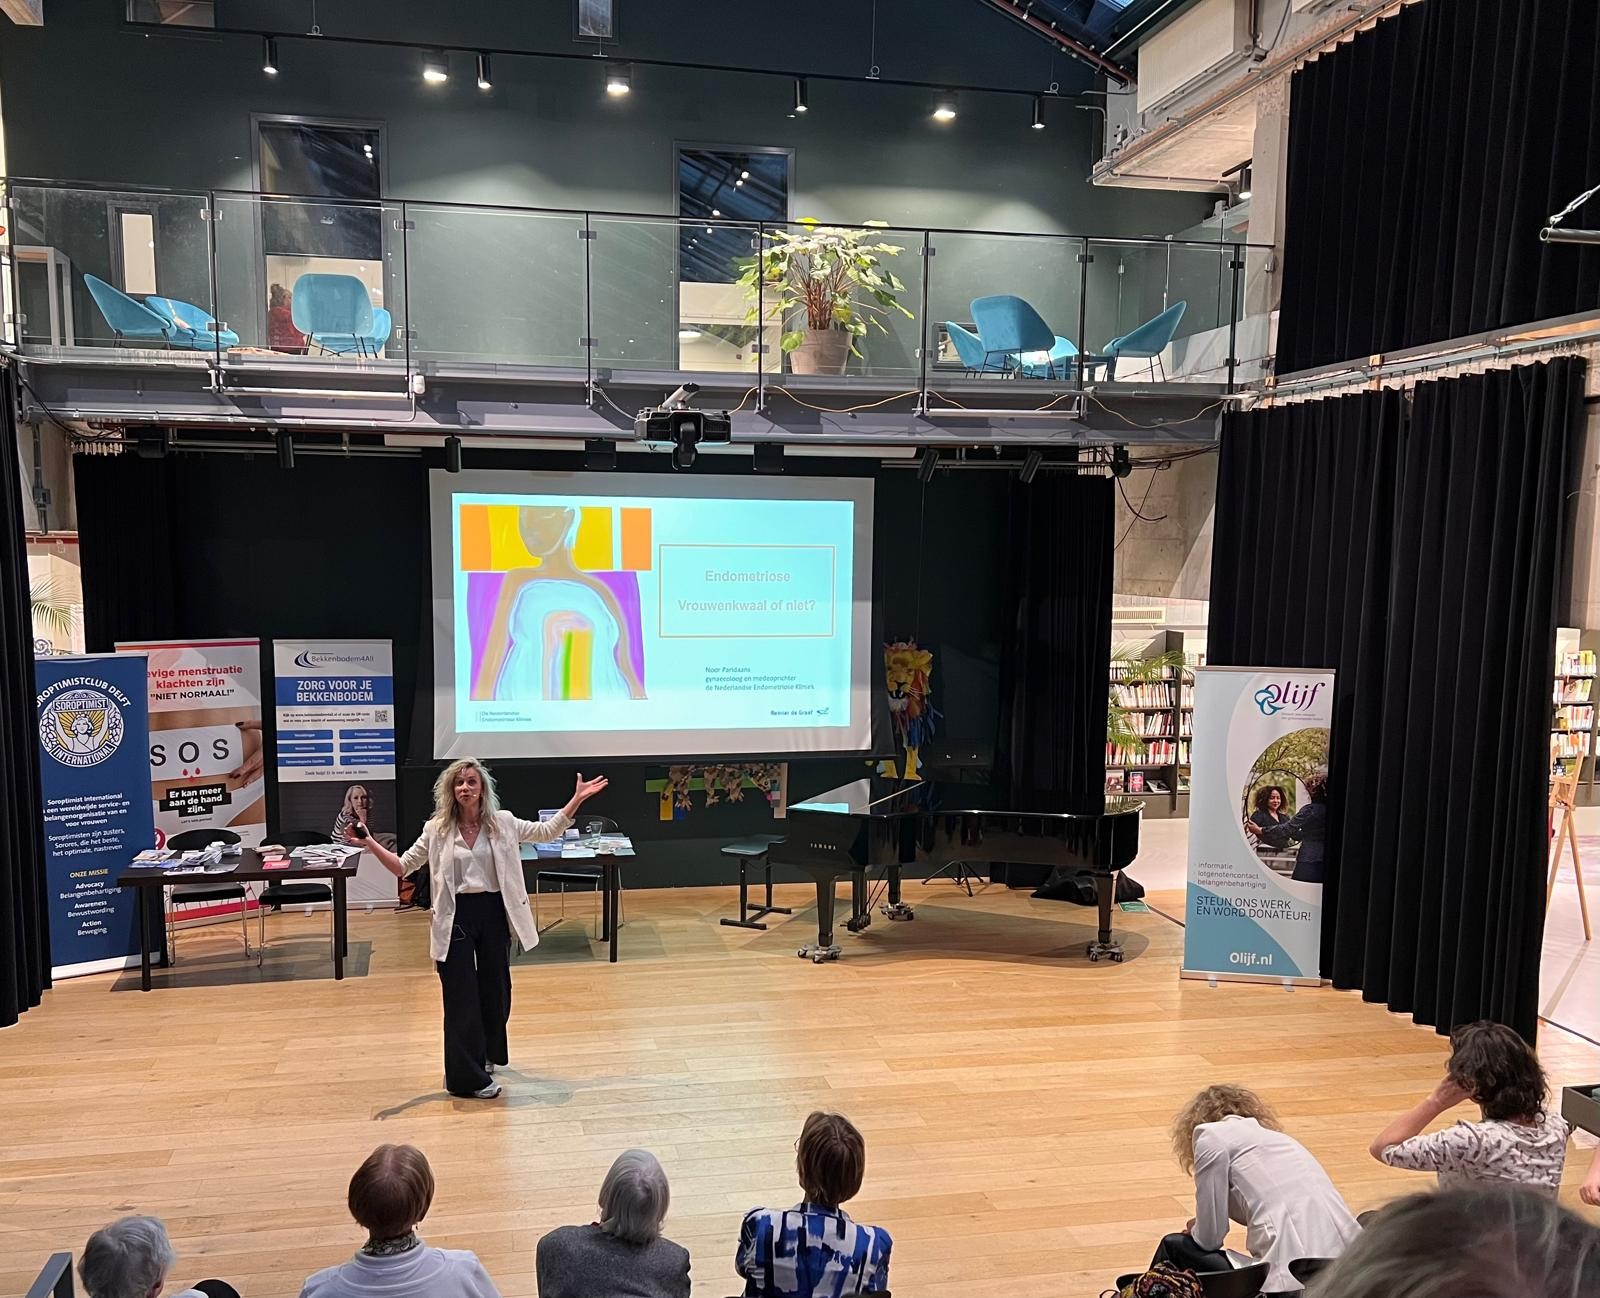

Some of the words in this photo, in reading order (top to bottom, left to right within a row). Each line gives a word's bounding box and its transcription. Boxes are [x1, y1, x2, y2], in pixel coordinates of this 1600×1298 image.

[705, 570, 791, 582] Endometriose
[678, 599, 767, 611] Vrouwenkwaal
[771, 599, 784, 611] of
[786, 599, 816, 611] niet?
[178, 665, 243, 676] menstruatie
[156, 680, 203, 689] klachten
[206, 678, 225, 688] zijn
[297, 680, 326, 690] ZORG
[328, 680, 357, 690] VOOR
[360, 680, 373, 690] JE
[108, 686, 132, 707] DELFT
[296, 692, 374, 702] BEKKENBODEM
[55, 700, 107, 712] SOROPTIMIST
[53, 744, 114, 765] INTERNATIONAL
[200, 787, 222, 796] meer
[48, 796, 83, 806] Soroptimist
[84, 792, 123, 802] International
[169, 799, 186, 807] aan
[187, 797, 199, 805] de
[200, 794, 223, 804] hand
[60, 804, 97, 812] wereldwijde
[187, 805, 206, 814] zijn.
[44, 811, 106, 822] belangenorganisatie
[48, 832, 90, 842] Soroptimisten
[70, 870, 88, 878] ONZE
[1198, 870, 1259, 880] lotgenotencontact
[75, 882, 104, 890] Advocacy
[1198, 879, 1267, 889] belangenbehartiging
[60, 886, 122, 900] Belangenbehartiging
[74, 900, 108, 909] Awareness
[1196, 895, 1232, 906] STEUN
[1234, 898, 1258, 908] ONS
[1260, 899, 1292, 910] WERK
[68, 907, 115, 918] Bewustwording
[1196, 906, 1211, 915] EN
[1214, 907, 1246, 918] WORD
[1248, 909, 1311, 921] DONATEUR!
[78, 928, 108, 936] Beweging
[1230, 952, 1272, 966] Olijf.nl
